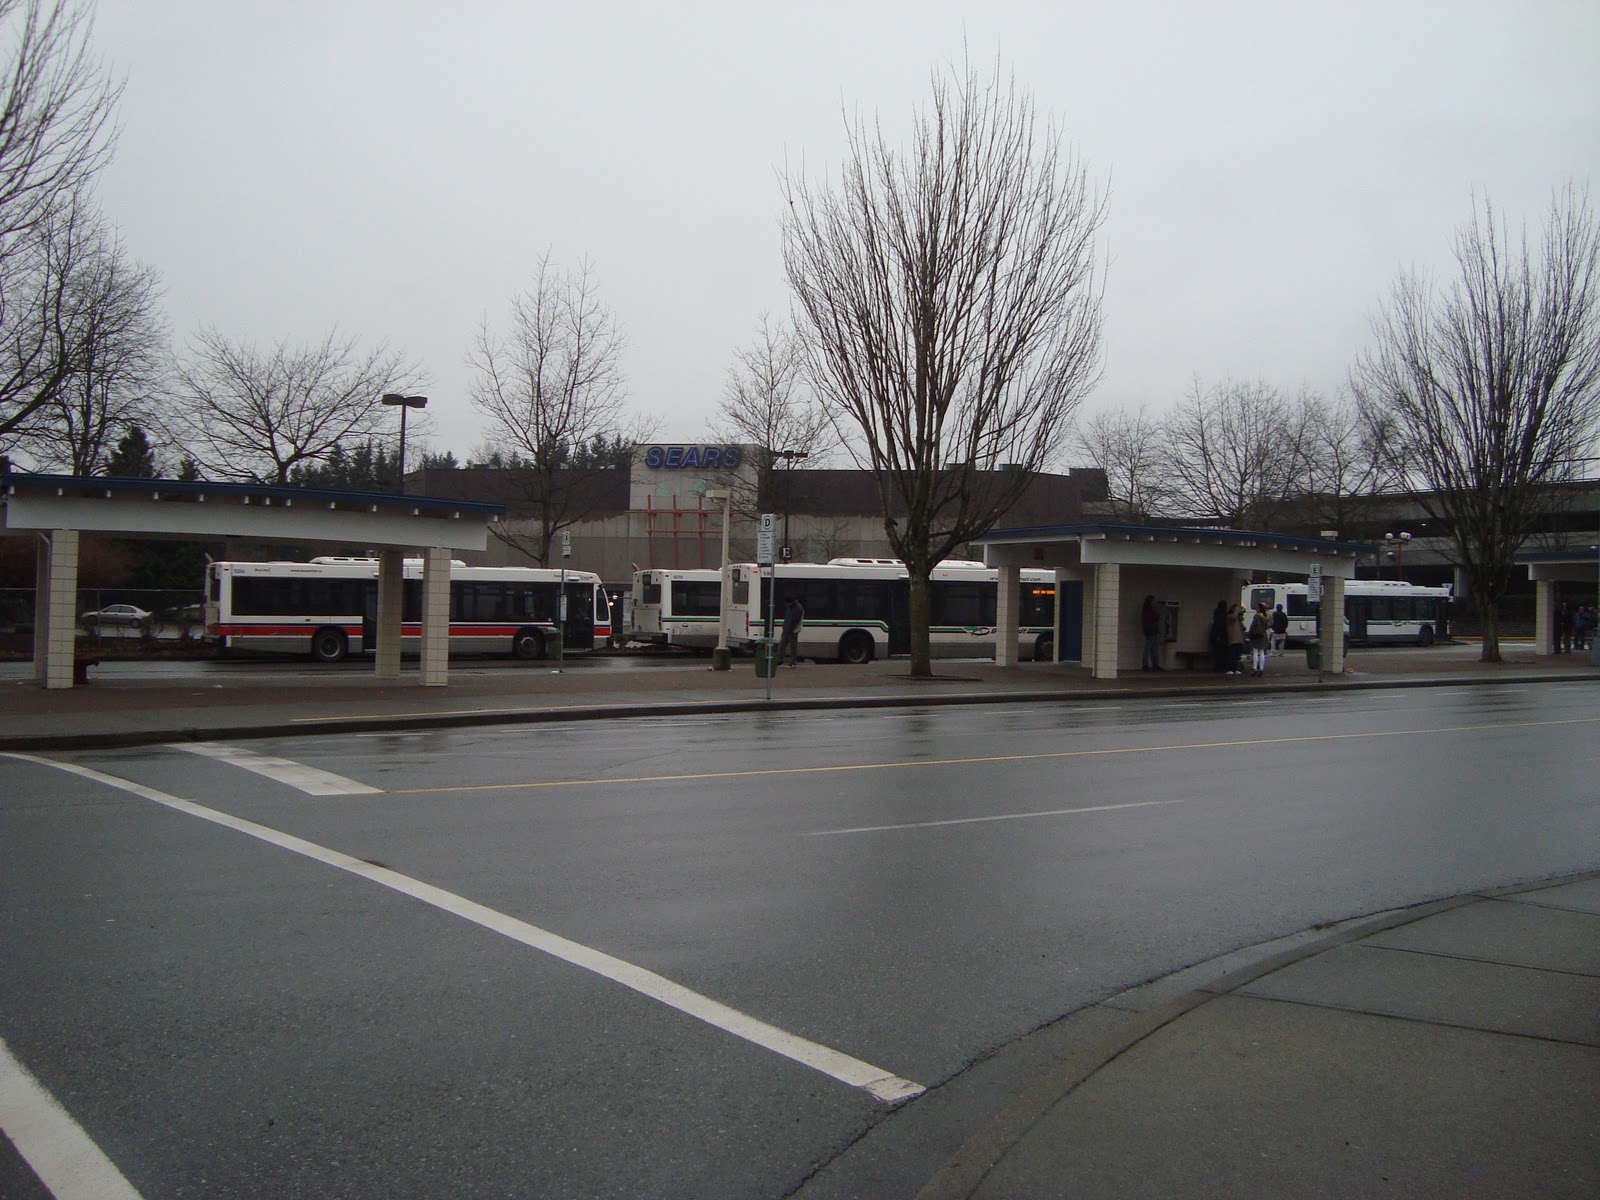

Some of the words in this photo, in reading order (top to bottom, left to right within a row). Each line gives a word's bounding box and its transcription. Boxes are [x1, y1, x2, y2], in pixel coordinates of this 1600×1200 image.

[645, 446, 741, 469] SEARS
[765, 518, 771, 527] D
[782, 547, 791, 558] E
